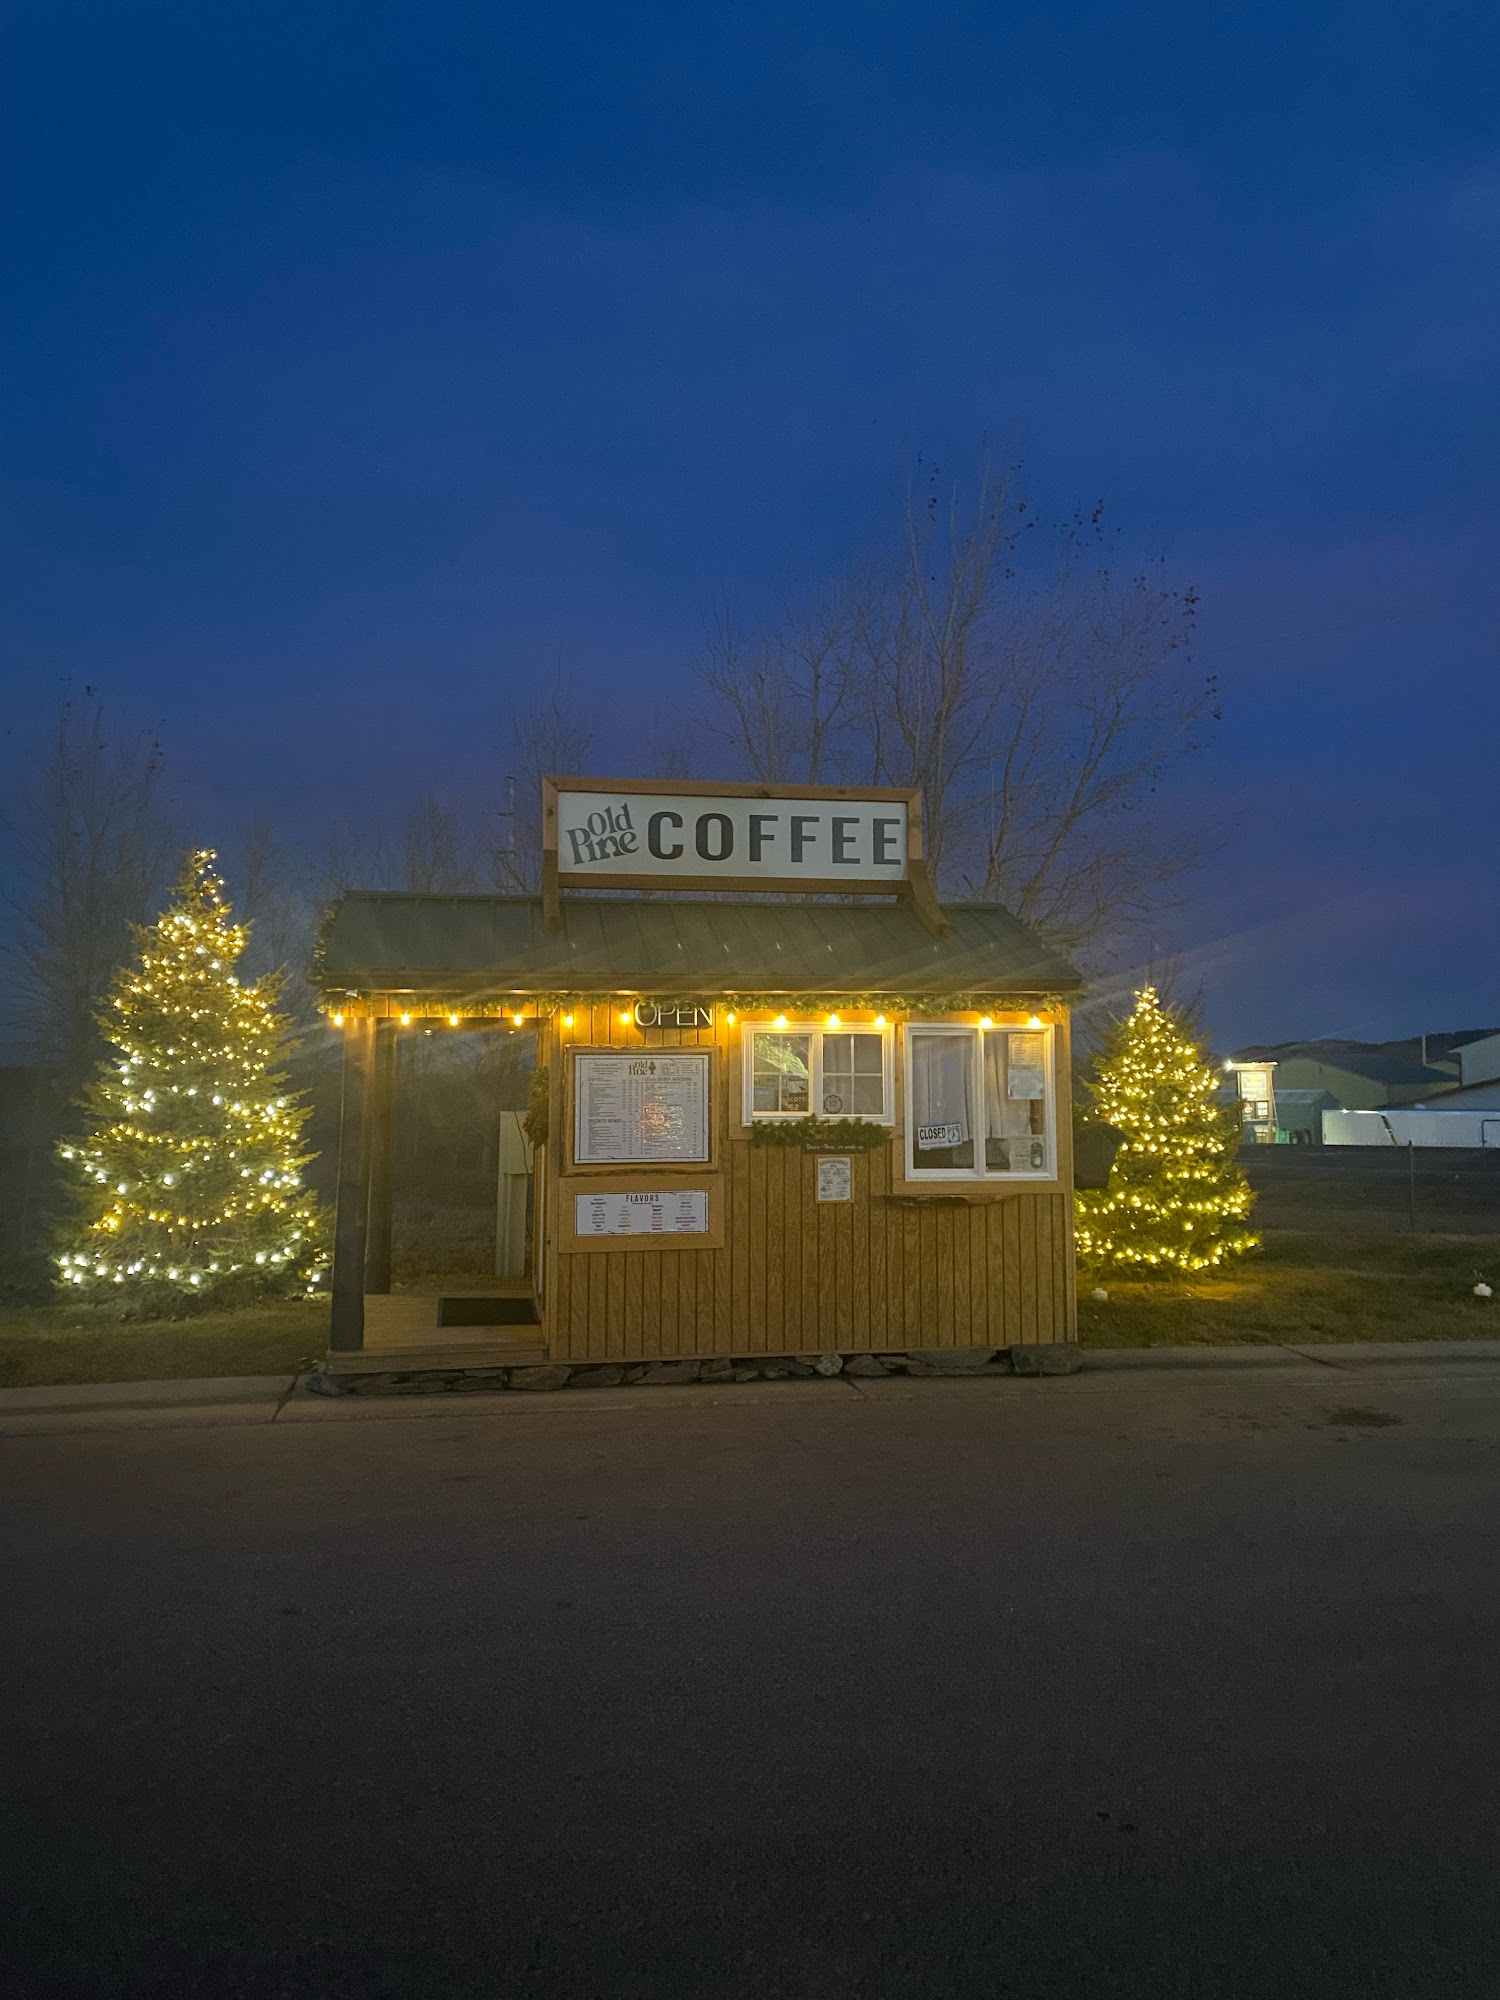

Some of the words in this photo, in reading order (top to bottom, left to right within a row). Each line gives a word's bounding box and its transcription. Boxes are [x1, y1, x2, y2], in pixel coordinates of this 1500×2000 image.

[587, 803, 634, 836] Old
[566, 828, 639, 865] Pine
[648, 811, 901, 865] COFFEE
[634, 1000, 713, 1026] OPEN
[635, 1060, 648, 1069] Old
[919, 1127, 946, 1140] CLOSED
[626, 1194, 659, 1203] FLAVORS
